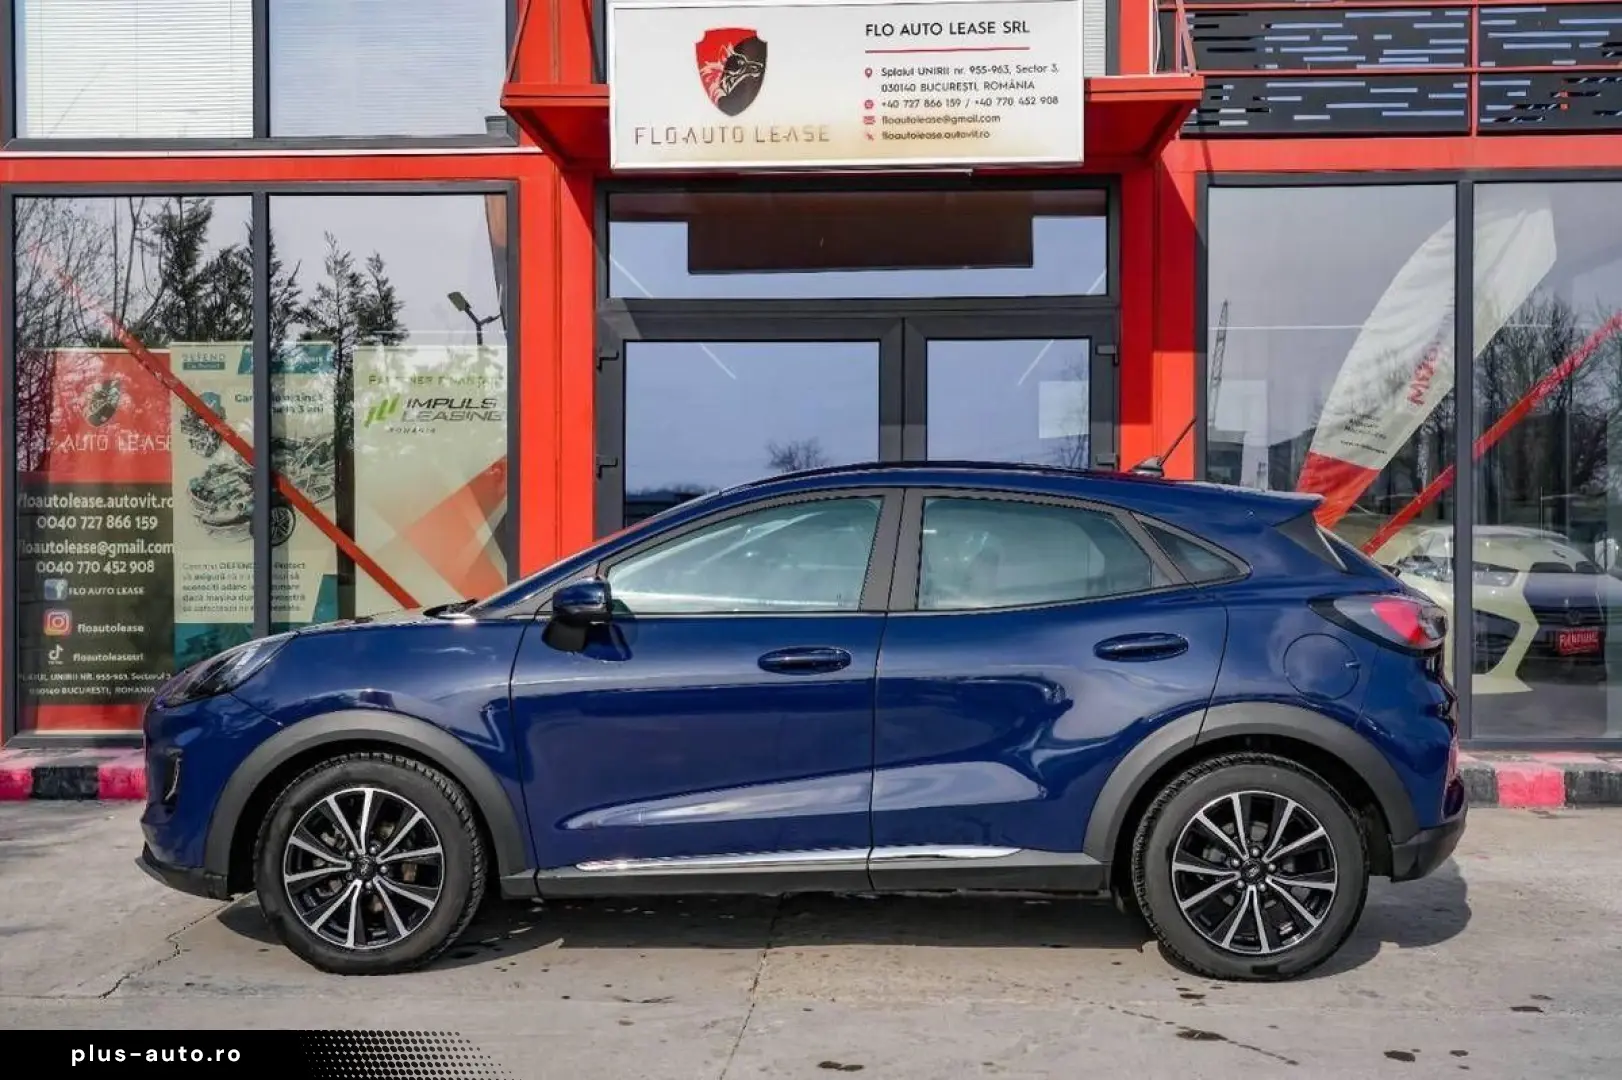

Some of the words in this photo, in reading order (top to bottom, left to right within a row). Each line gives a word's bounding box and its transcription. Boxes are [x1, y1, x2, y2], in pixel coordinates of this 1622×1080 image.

[866, 23, 894, 36] FLO
[900, 23, 942, 36] AUTO
[950, 22, 996, 35] LEASE
[1002, 21, 1030, 34] SRL
[881, 67, 914, 78] Splaiul
[918, 67, 949, 77] UNIRII
[969, 66, 1011, 76] 955-963,
[1016, 64, 1047, 74] Sector
[881, 83, 915, 93] 030140
[984, 80, 1035, 91] ROMÂNIA
[881, 100, 899, 108] +40
[903, 100, 920, 108] 727
[924, 99, 942, 108] 866
[946, 99, 961, 108] 159
[975, 98, 992, 107] +40
[997, 97, 1014, 106] 770
[1019, 97, 1035, 106] 452
[1040, 96, 1059, 105] 908
[881, 114, 1001, 126] floautolease@gmail.com
[756, 125, 831, 143] LEASE
[881, 130, 990, 141] floautolease.autovit.ro
[406, 398, 498, 409] IMPULS
[402, 411, 502, 422] LEASING
[37, 516, 77, 530] 0040
[80, 515, 103, 530] 727
[106, 515, 132, 529] 866
[135, 515, 158, 530] 159
[36, 560, 74, 574] 0040
[77, 560, 100, 574] 770
[103, 560, 127, 574] 452
[130, 560, 154, 574] 908
[68, 587, 85, 596] FLO
[88, 587, 114, 596] AUTO
[117, 587, 144, 596] LEASE
[77, 623, 144, 634] floautolease
